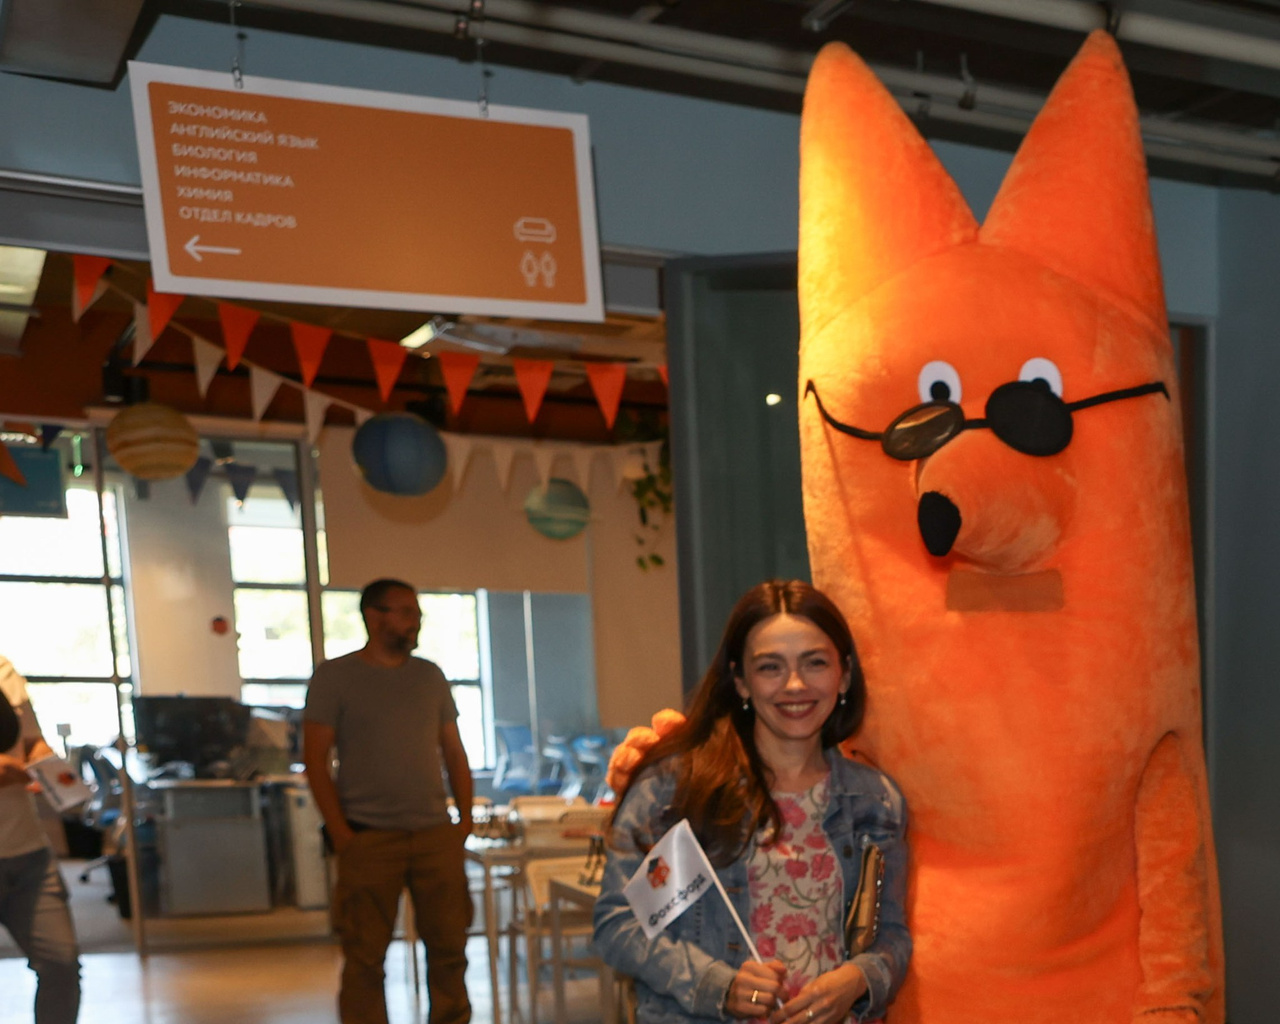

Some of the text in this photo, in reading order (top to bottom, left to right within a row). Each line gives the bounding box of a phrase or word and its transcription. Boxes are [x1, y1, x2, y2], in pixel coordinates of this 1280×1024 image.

[168, 101, 268, 124] ЭКОНОМИКА
[170, 122, 319, 149] АНГЛИЙСКИЙ ЯЗЫК
[171, 143, 258, 164] БИОЛОГИЯ
[174, 165, 295, 188] ИНФОРМАТИКА
[177, 186, 233, 202] ХИМИЯ
[178, 206, 298, 229] ОТДЕЛ КАДРОВ
